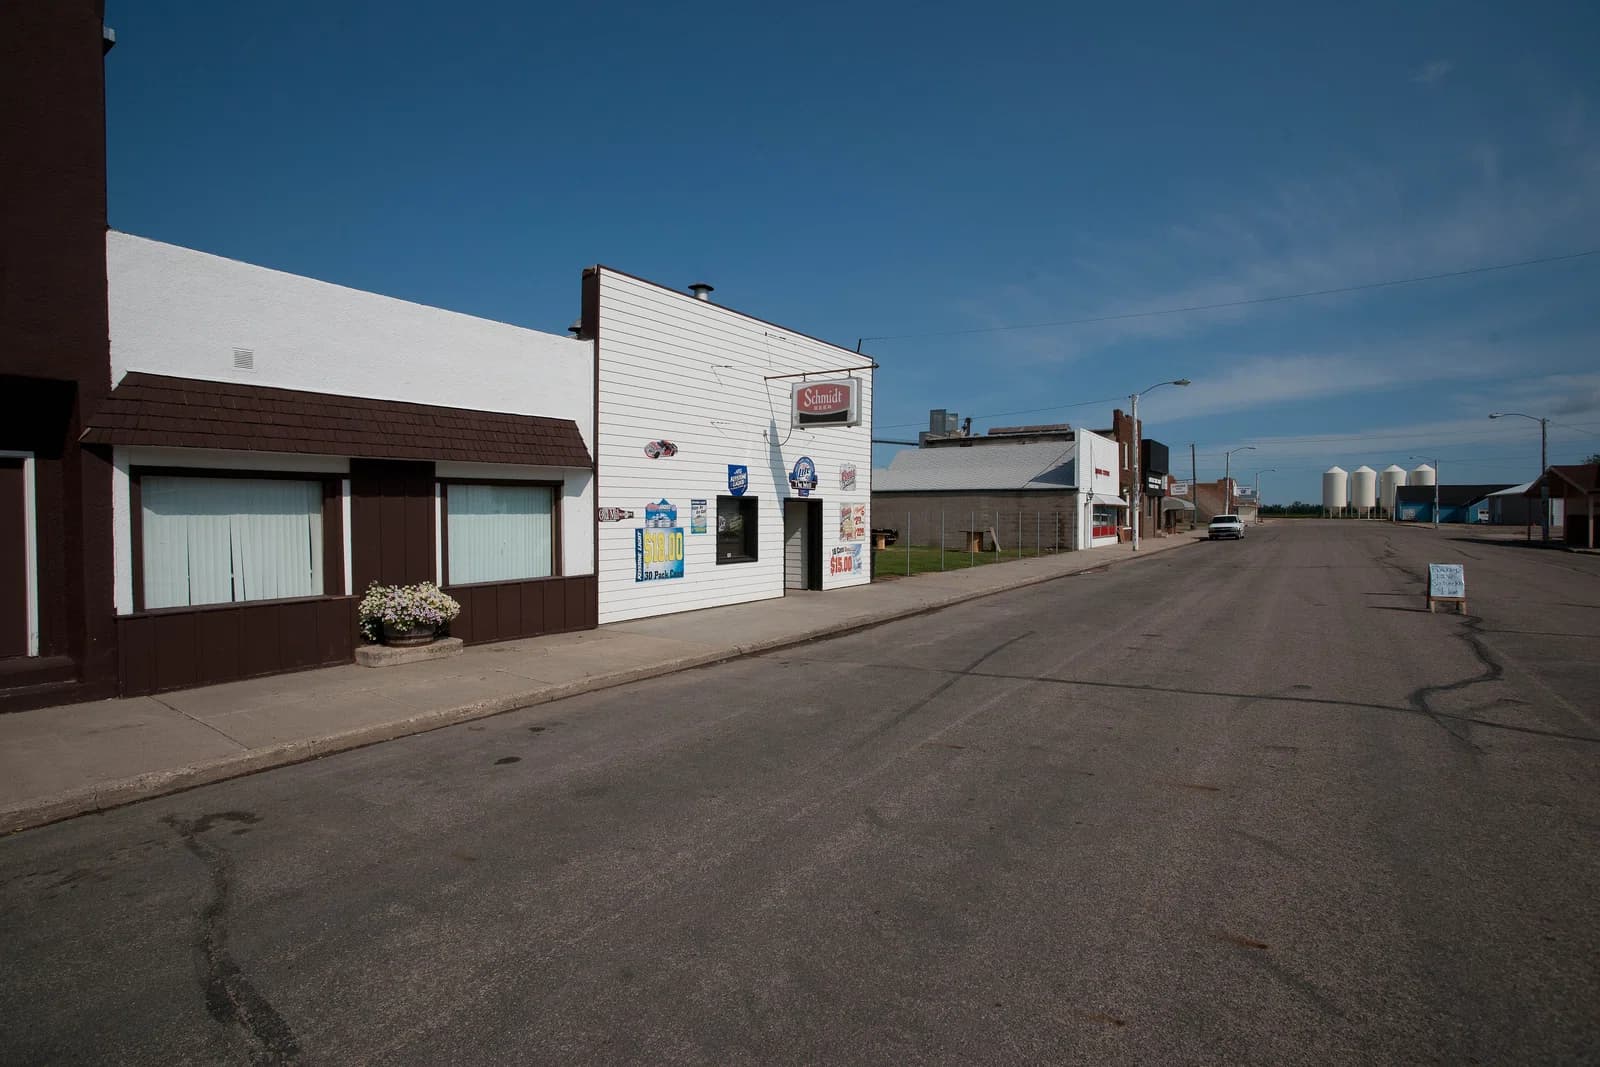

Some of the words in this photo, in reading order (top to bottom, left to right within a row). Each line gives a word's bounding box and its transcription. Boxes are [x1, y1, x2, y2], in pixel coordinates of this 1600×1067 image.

[803, 387, 842, 407] Schmidt
[644, 529, 683, 568] $18.00
[644, 571, 653, 580] 30
[654, 569, 669, 579] Pack
[830, 555, 852, 576] $15.00
